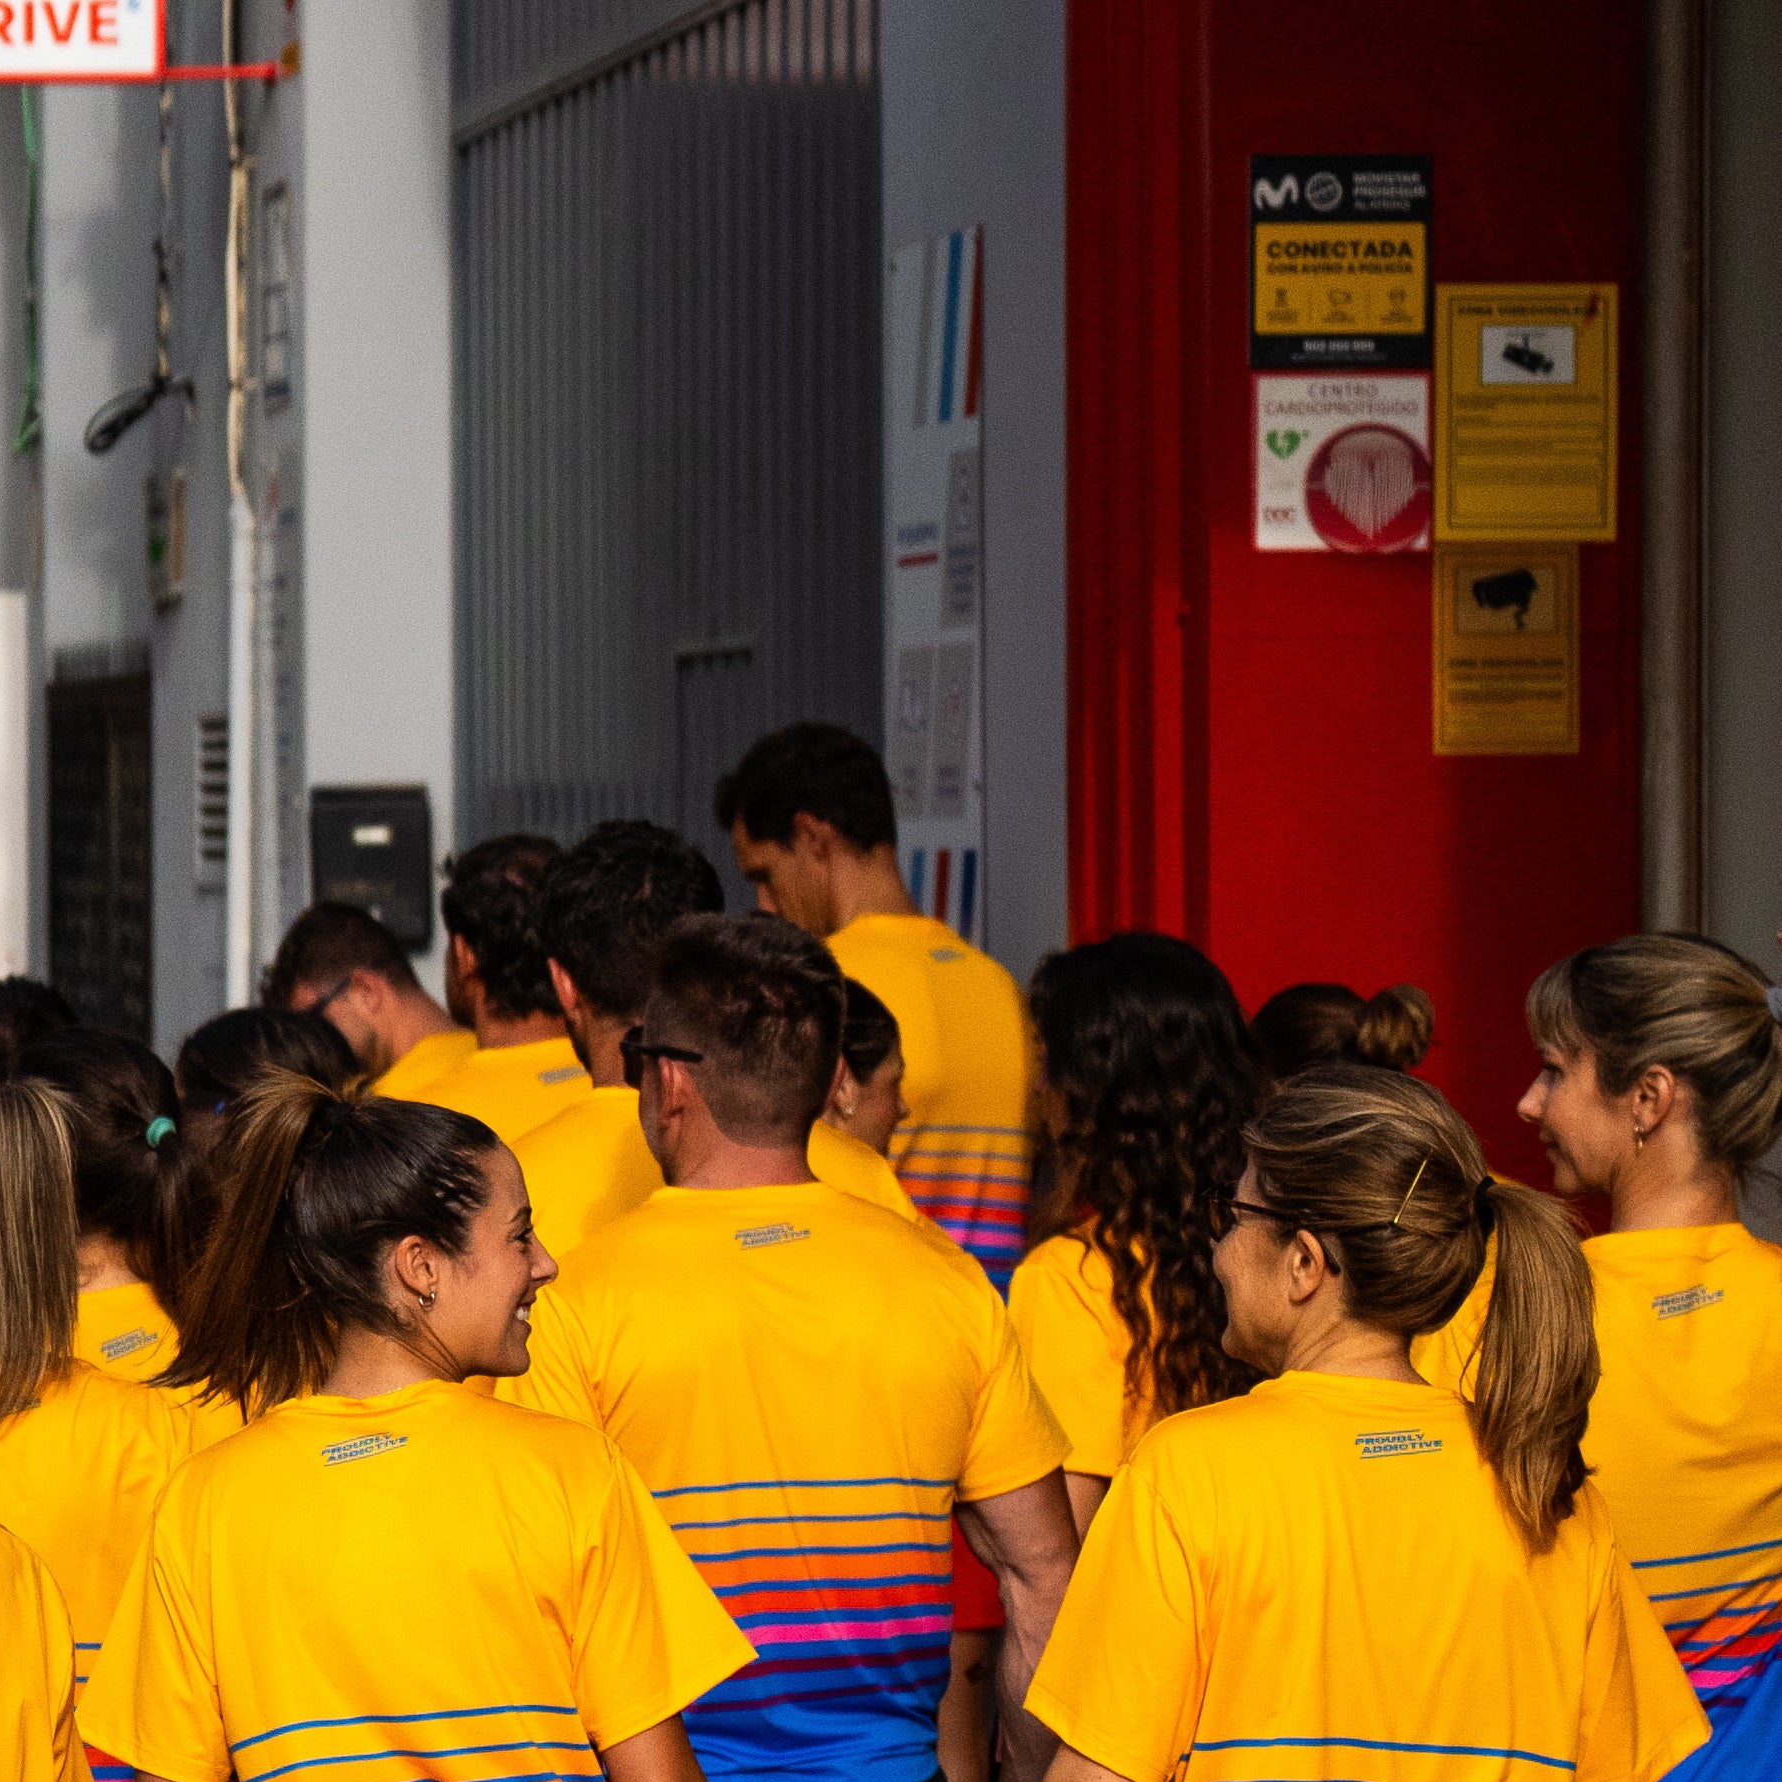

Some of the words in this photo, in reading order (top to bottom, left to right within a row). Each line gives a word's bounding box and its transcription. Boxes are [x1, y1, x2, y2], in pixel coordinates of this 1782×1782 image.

[1266, 240, 1413, 259] CONECTADA
[1308, 384, 1379, 398] CENTRO
[320, 1434, 392, 1456] PROUDLY
[1355, 1433, 1424, 1446] PROUDLY
[1362, 1439, 1443, 1454] ADDICTIVE
